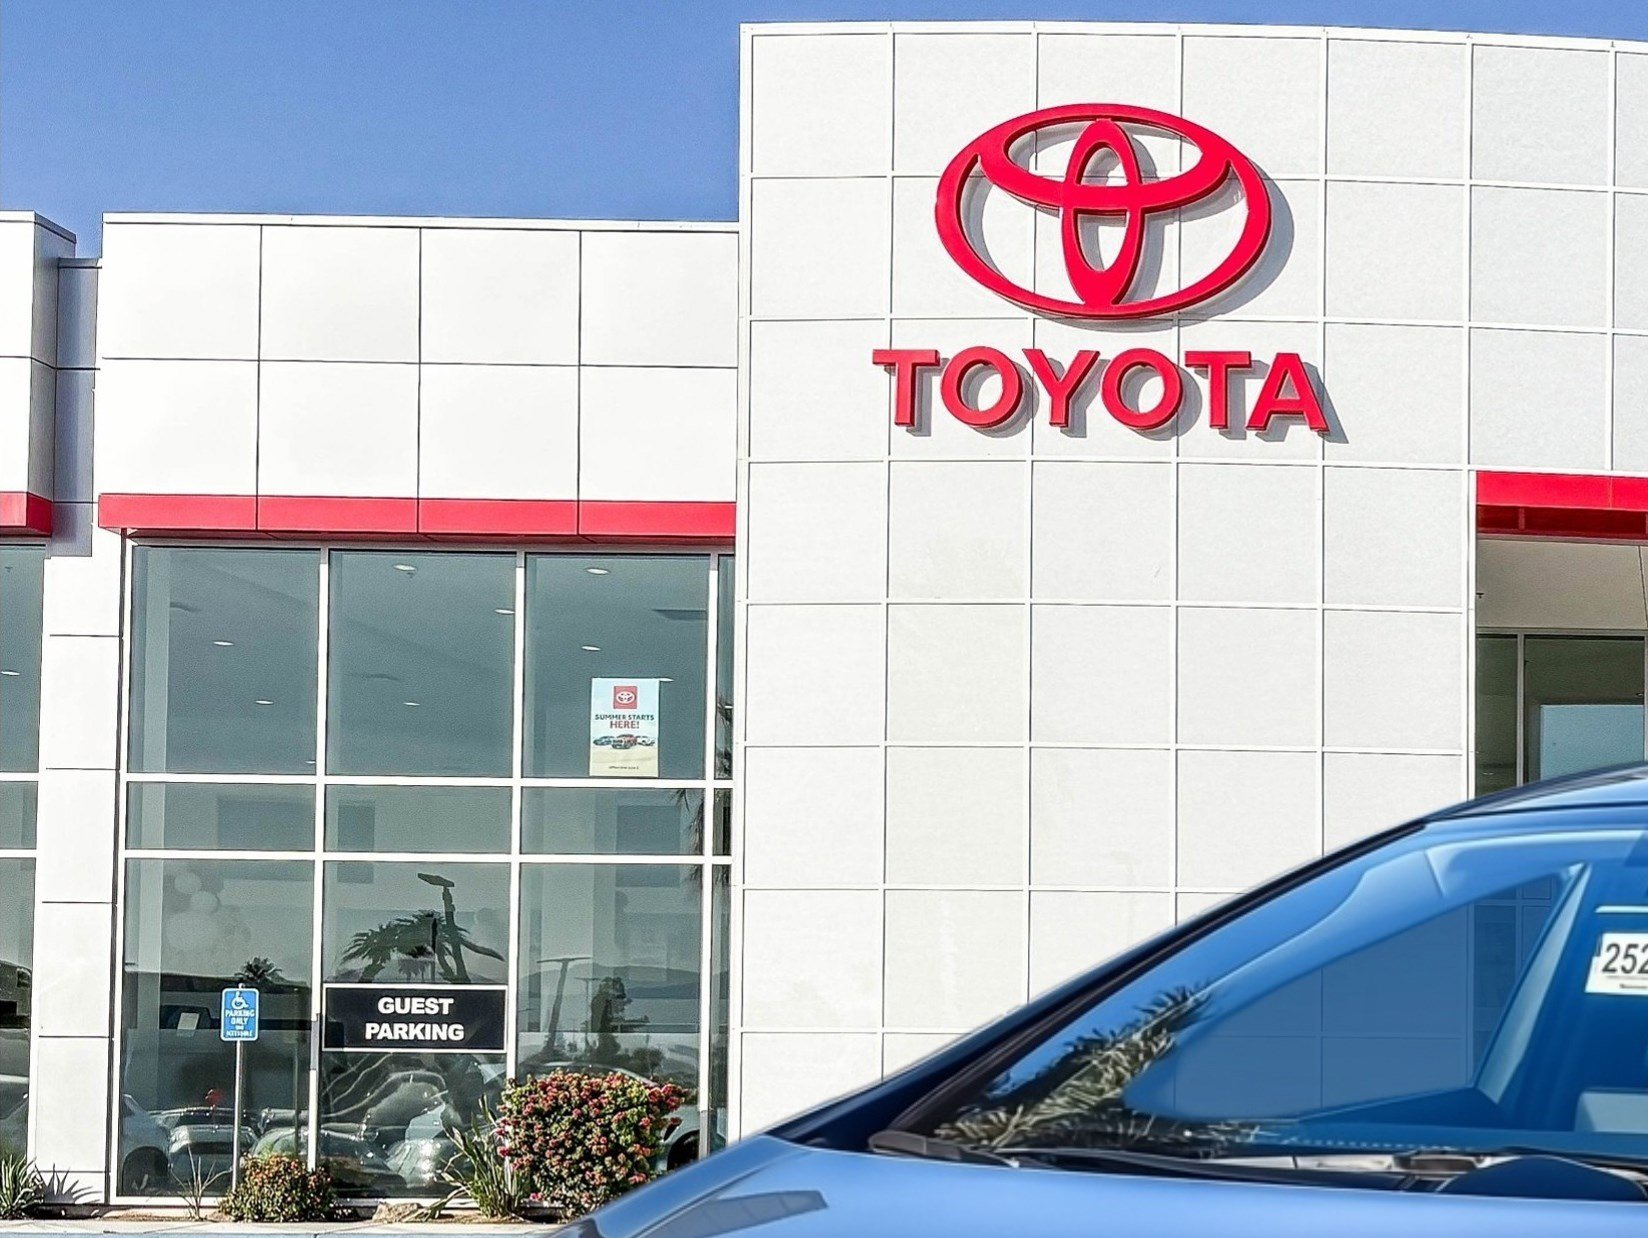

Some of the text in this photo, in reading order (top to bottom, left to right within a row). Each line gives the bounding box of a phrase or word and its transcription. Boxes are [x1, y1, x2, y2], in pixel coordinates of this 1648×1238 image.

[872, 345, 1331, 434] TOYOTA
[610, 720, 639, 729] HERE!
[378, 996, 454, 1015] GUEST
[225, 1009, 255, 1017] PARKING
[230, 1017, 248, 1025] ONLY
[365, 1022, 464, 1041] PARKING
